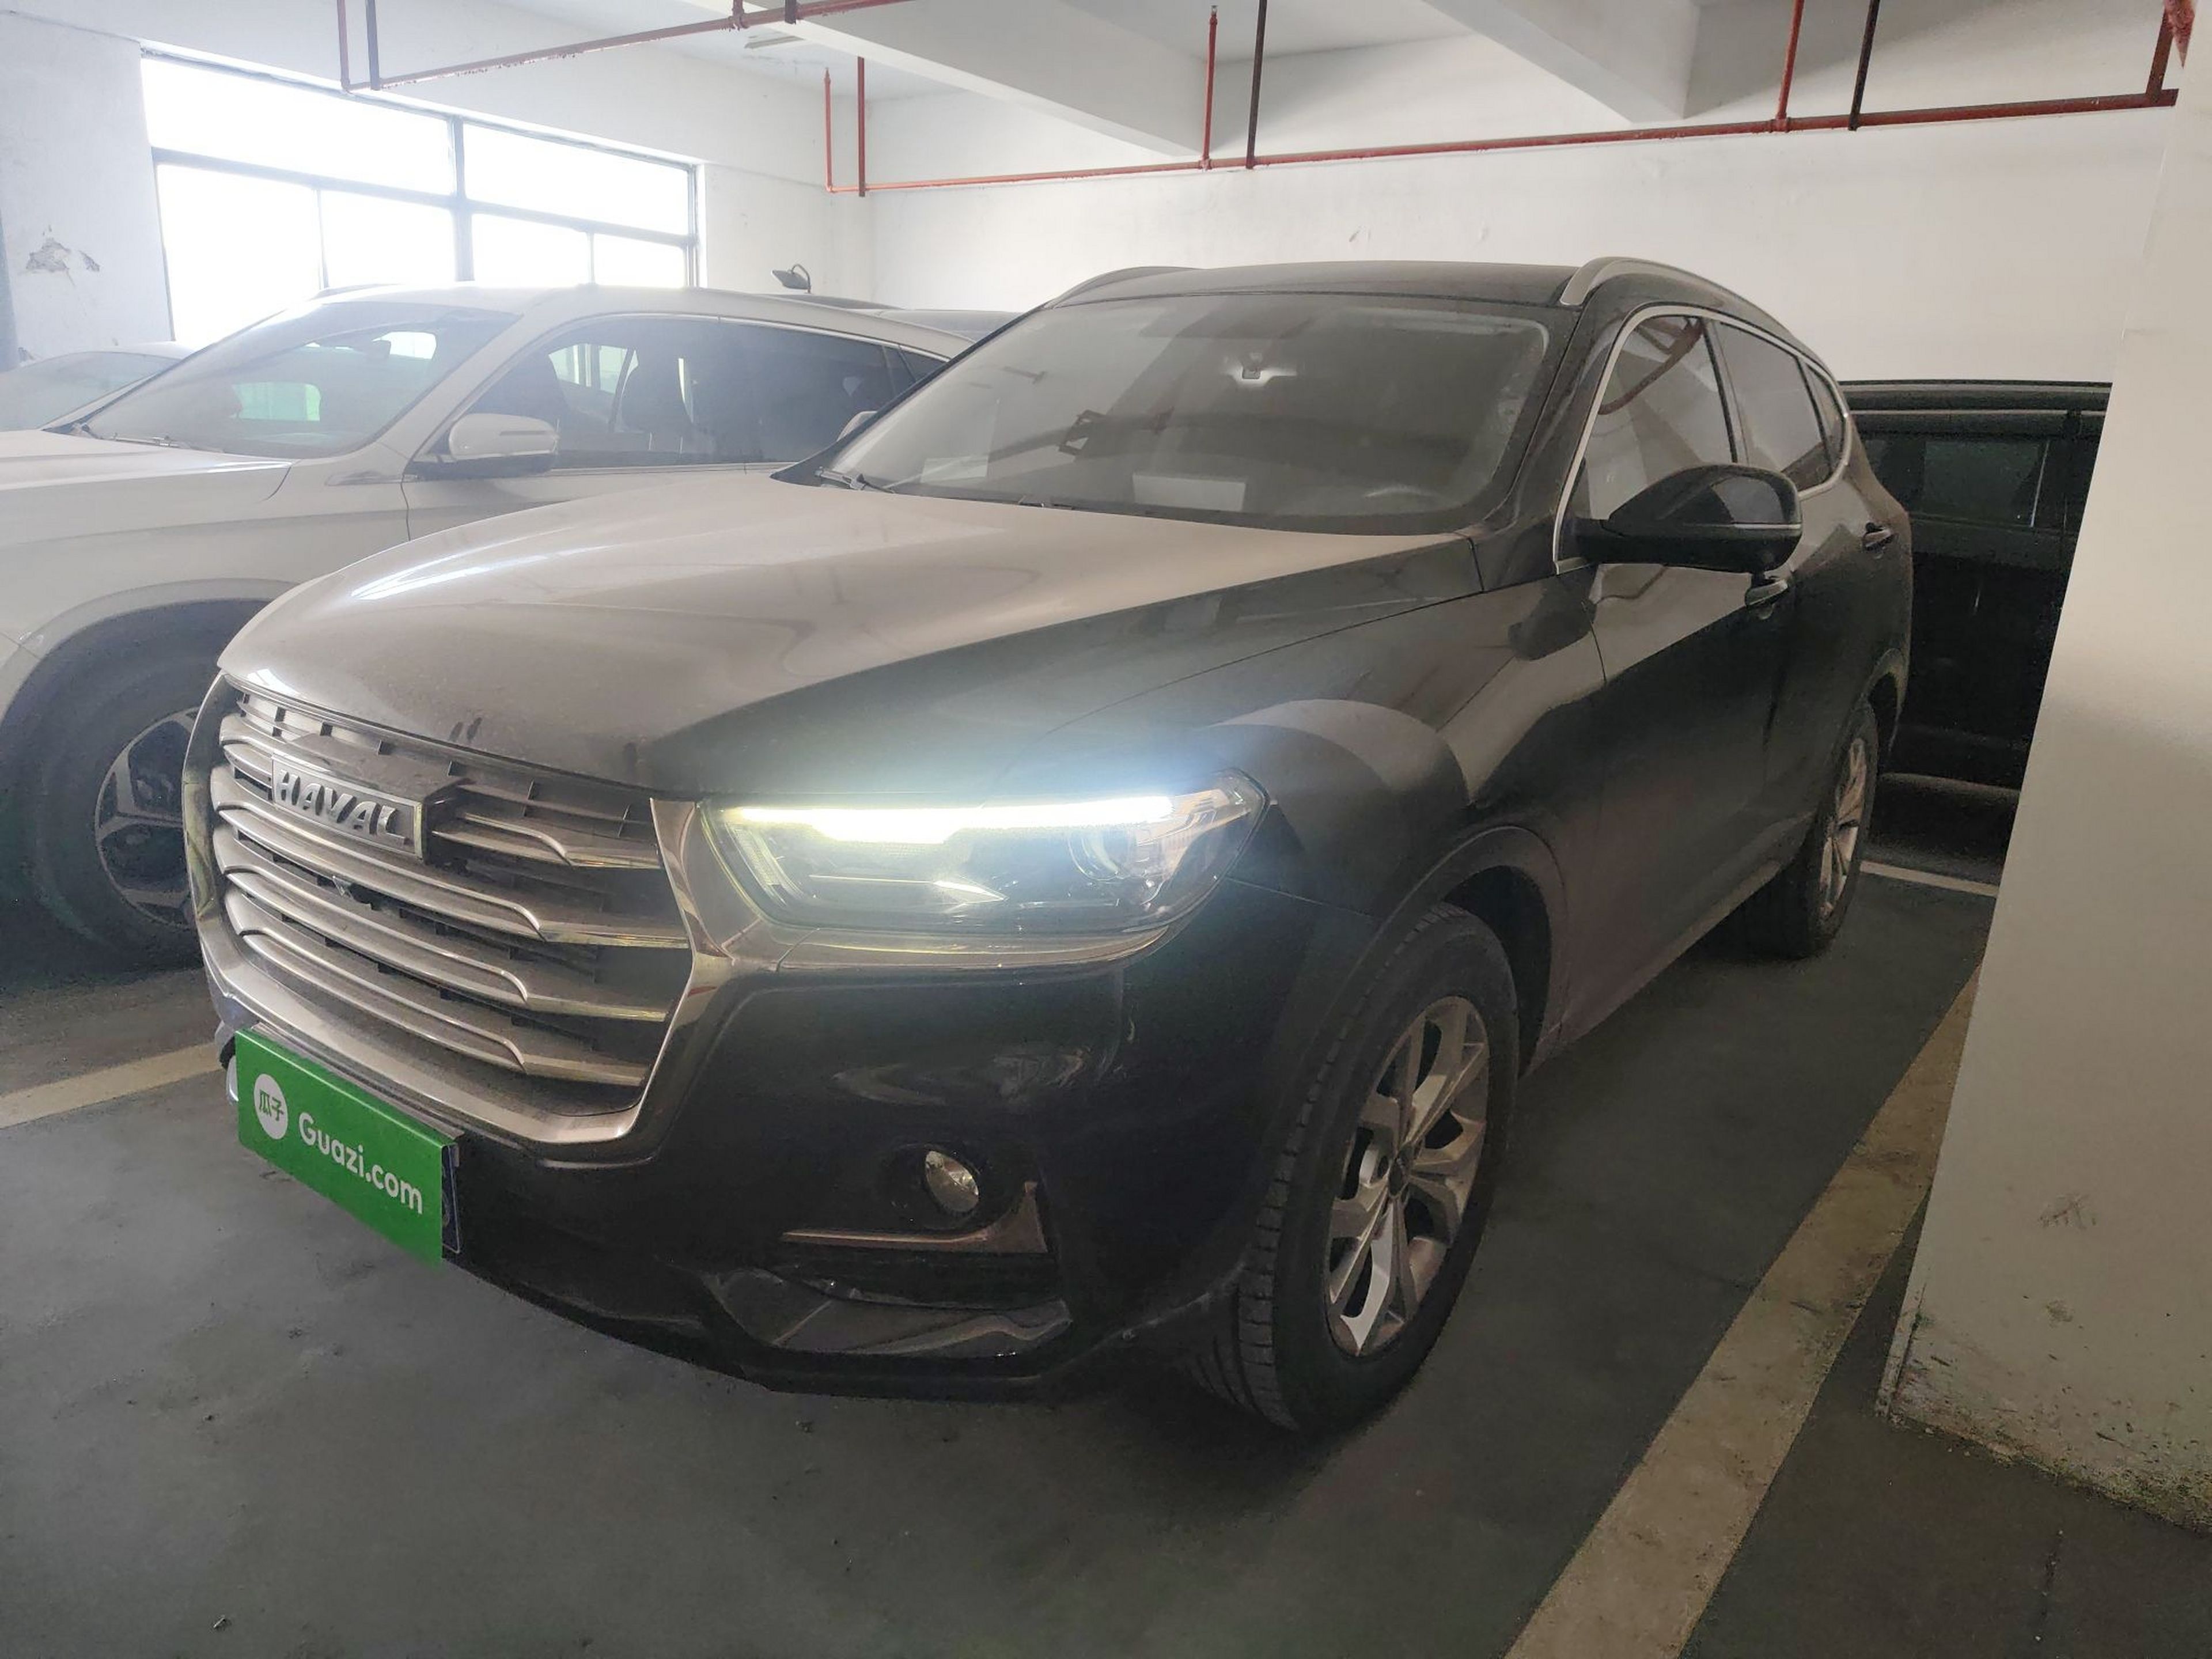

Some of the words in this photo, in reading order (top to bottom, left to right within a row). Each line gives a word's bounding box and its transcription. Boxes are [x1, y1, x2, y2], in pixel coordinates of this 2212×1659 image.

[275, 769, 408, 842] HAVAL
[259, 1089, 285, 1122] 瓜子
[298, 1112, 423, 1214] Guazi.com
